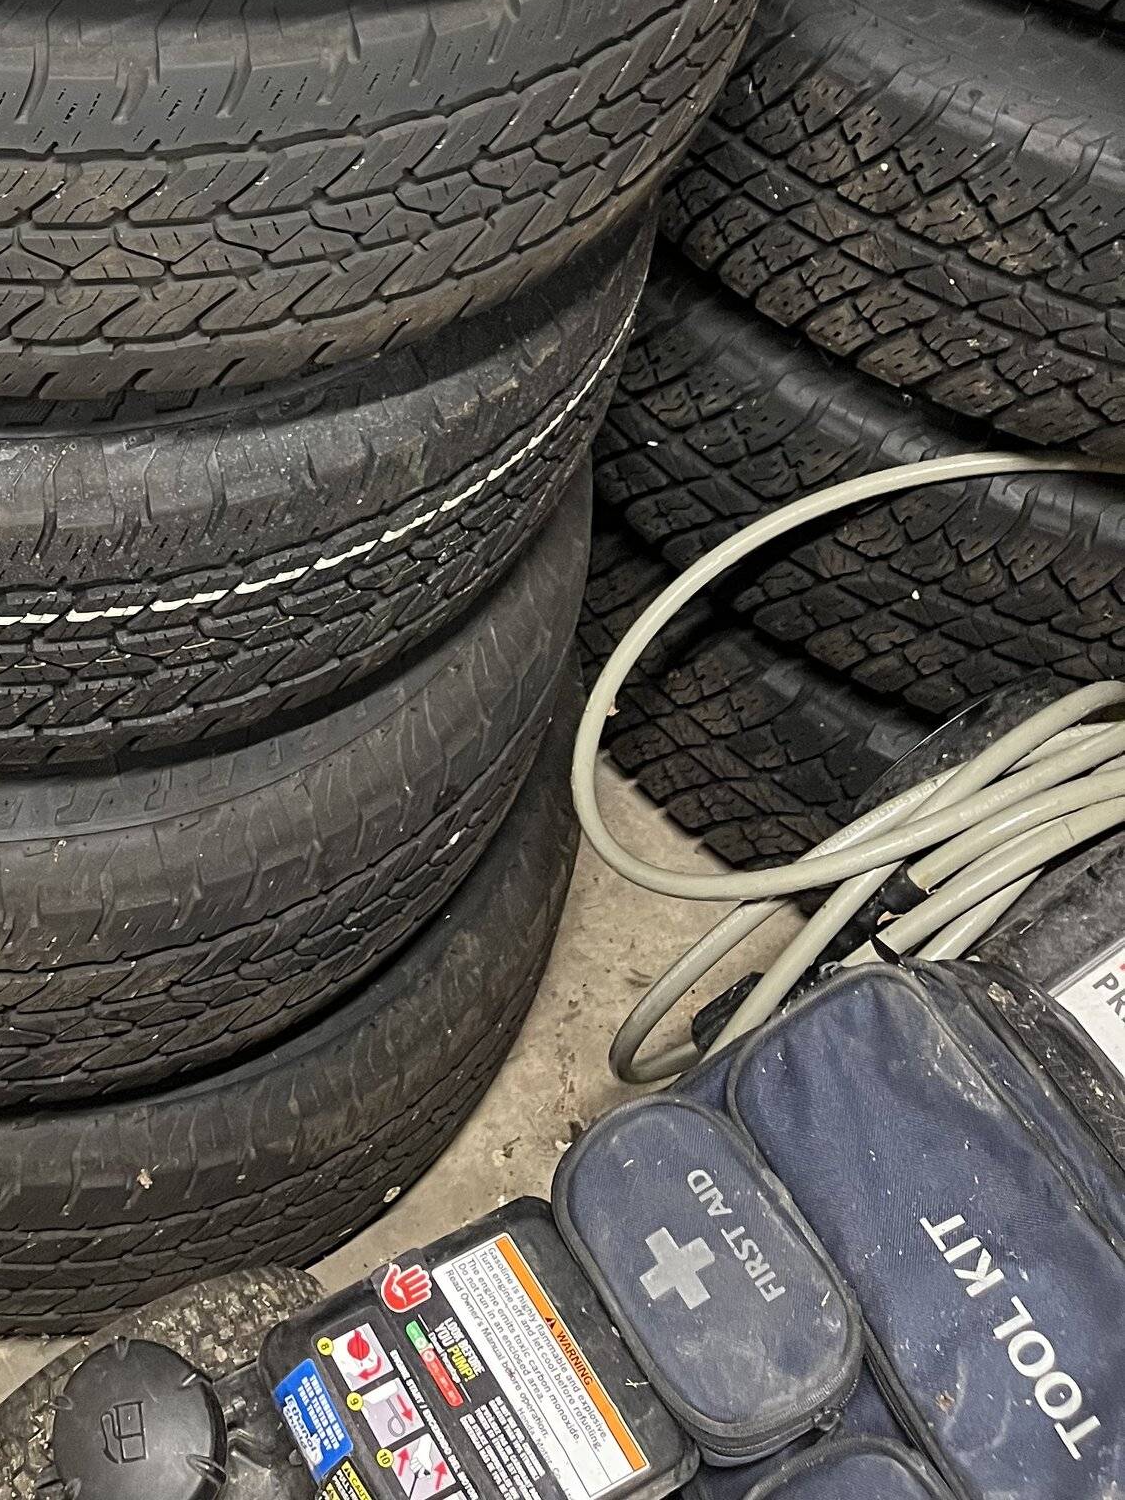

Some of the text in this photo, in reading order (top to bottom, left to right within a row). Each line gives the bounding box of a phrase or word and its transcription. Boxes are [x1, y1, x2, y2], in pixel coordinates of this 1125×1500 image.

[1092, 971, 1125, 1023] PR
[687, 1169, 787, 1302] FIRST AID
[433, 1322, 455, 1348] YOU
[446, 1343, 476, 1382] PUMP!
[443, 1315, 485, 1376] LOOK BEFORE
[445, 1269, 463, 1292] Read
[481, 1326, 505, 1360] Manual
[458, 1262, 546, 1403] Do not run in an enclosed area.
[466, 1258, 481, 1276] The
[476, 1275, 500, 1307] engine
[496, 1307, 516, 1334] emits
[512, 1334, 531, 1358] toxic
[527, 1358, 552, 1393] carbon
[478, 1250, 495, 1272] Turn
[491, 1271, 515, 1304] engine
[511, 1303, 524, 1318] off
[520, 1317, 535, 1336] and
[531, 1336, 544, 1351] let
[540, 1350, 557, 1372] cool
[553, 1372, 577, 1405] before
[487, 1246, 514, 1285] Gasoline
[511, 1284, 520, 1294] is
[516, 1294, 538, 1324] highly
[535, 1323, 569, 1373] flammable
[565, 1373, 581, 1393] and
[555, 1330, 593, 1386] WARNING
[919, 1214, 1101, 1461] TOOL KIT
[287, 1397, 316, 1452] Ethanol
[378, 1452, 391, 1465] 10
